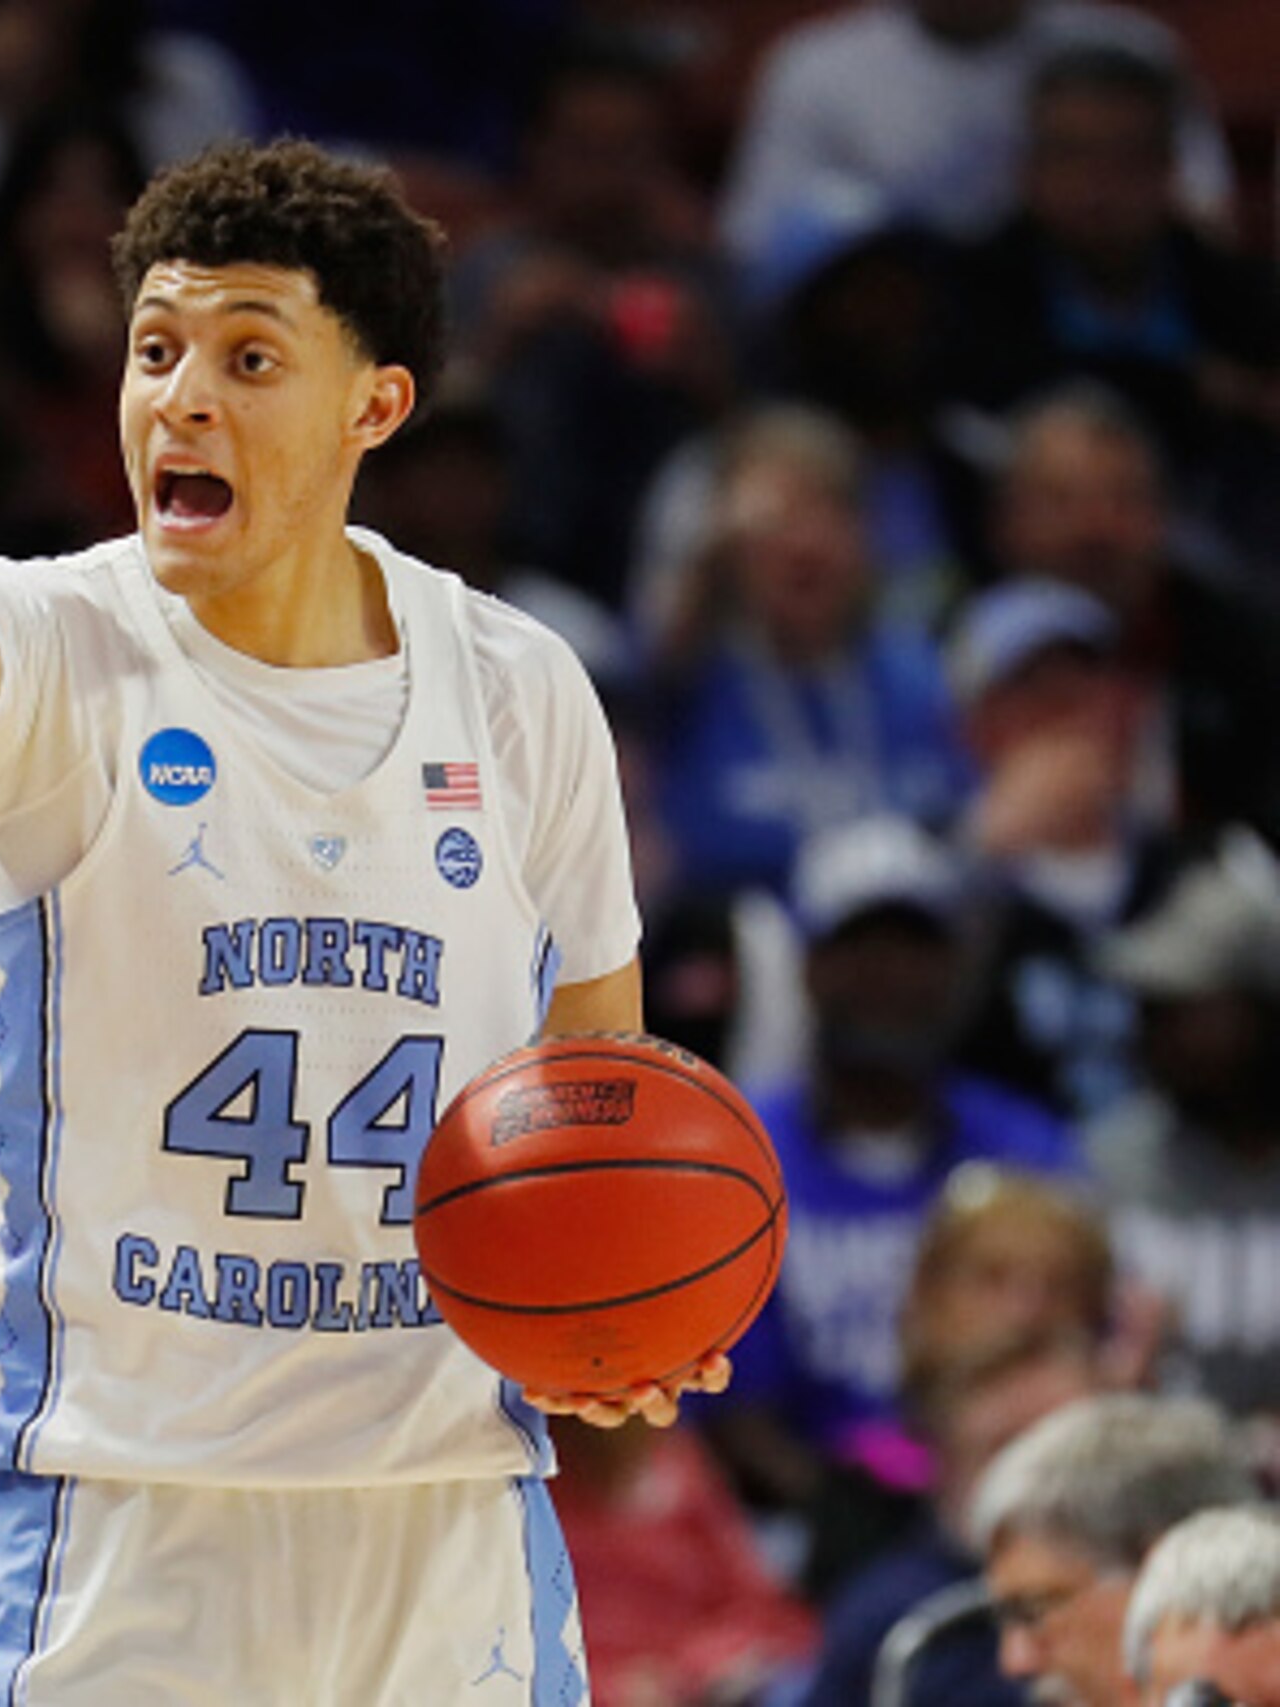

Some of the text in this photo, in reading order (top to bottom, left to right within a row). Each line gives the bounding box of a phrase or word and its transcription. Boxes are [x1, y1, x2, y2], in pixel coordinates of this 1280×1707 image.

[148, 762, 214, 786] NCAA
[198, 916, 445, 1006] NORTH
[161, 1028, 445, 1225] 44
